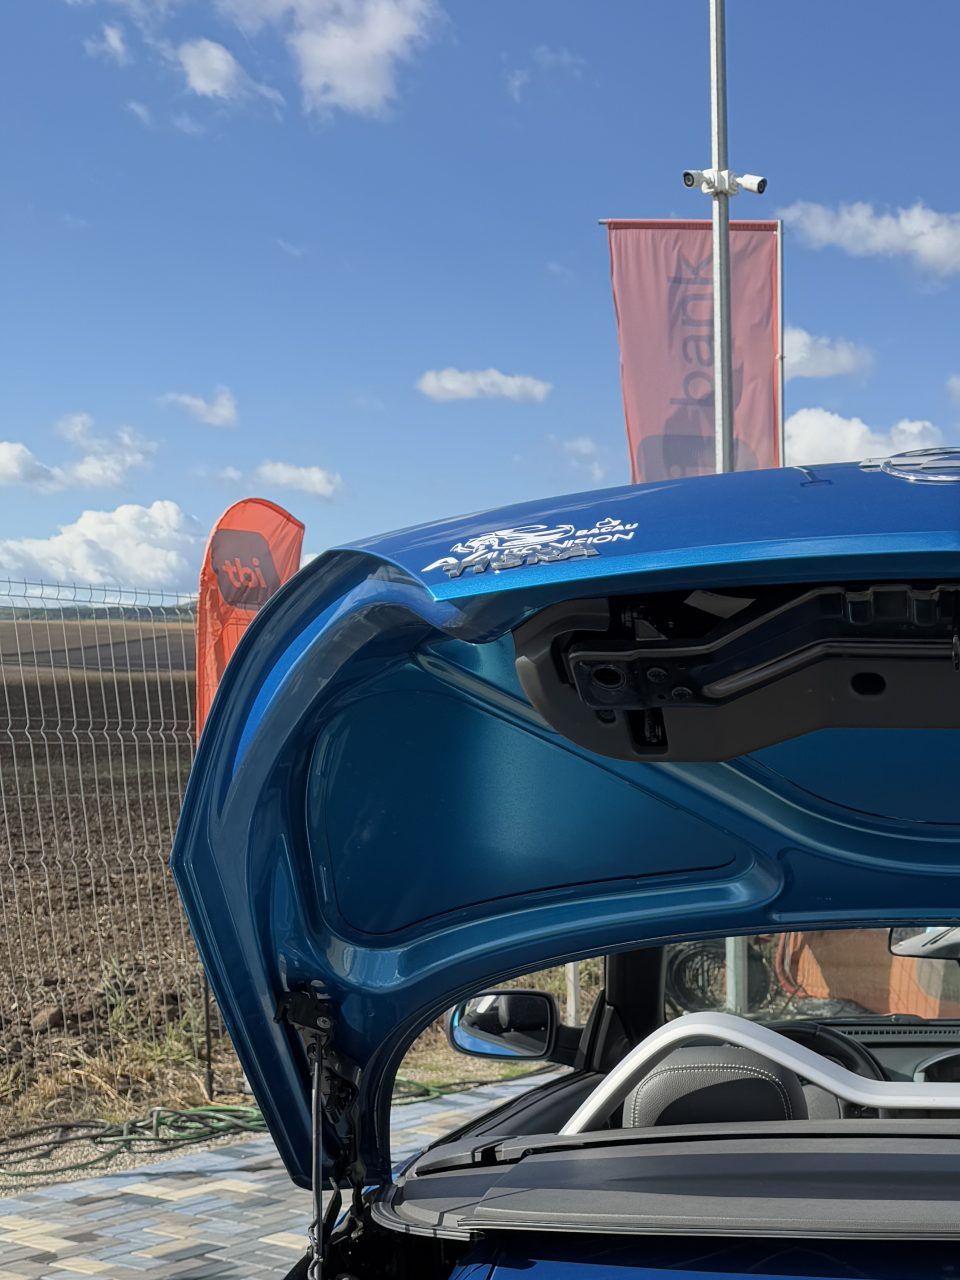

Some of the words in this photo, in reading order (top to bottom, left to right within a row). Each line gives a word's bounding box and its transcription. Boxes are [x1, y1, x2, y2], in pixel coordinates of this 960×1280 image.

[668, 253, 717, 407] bank
[576, 523, 638, 536] BACAU
[222, 557, 267, 588] tbi
